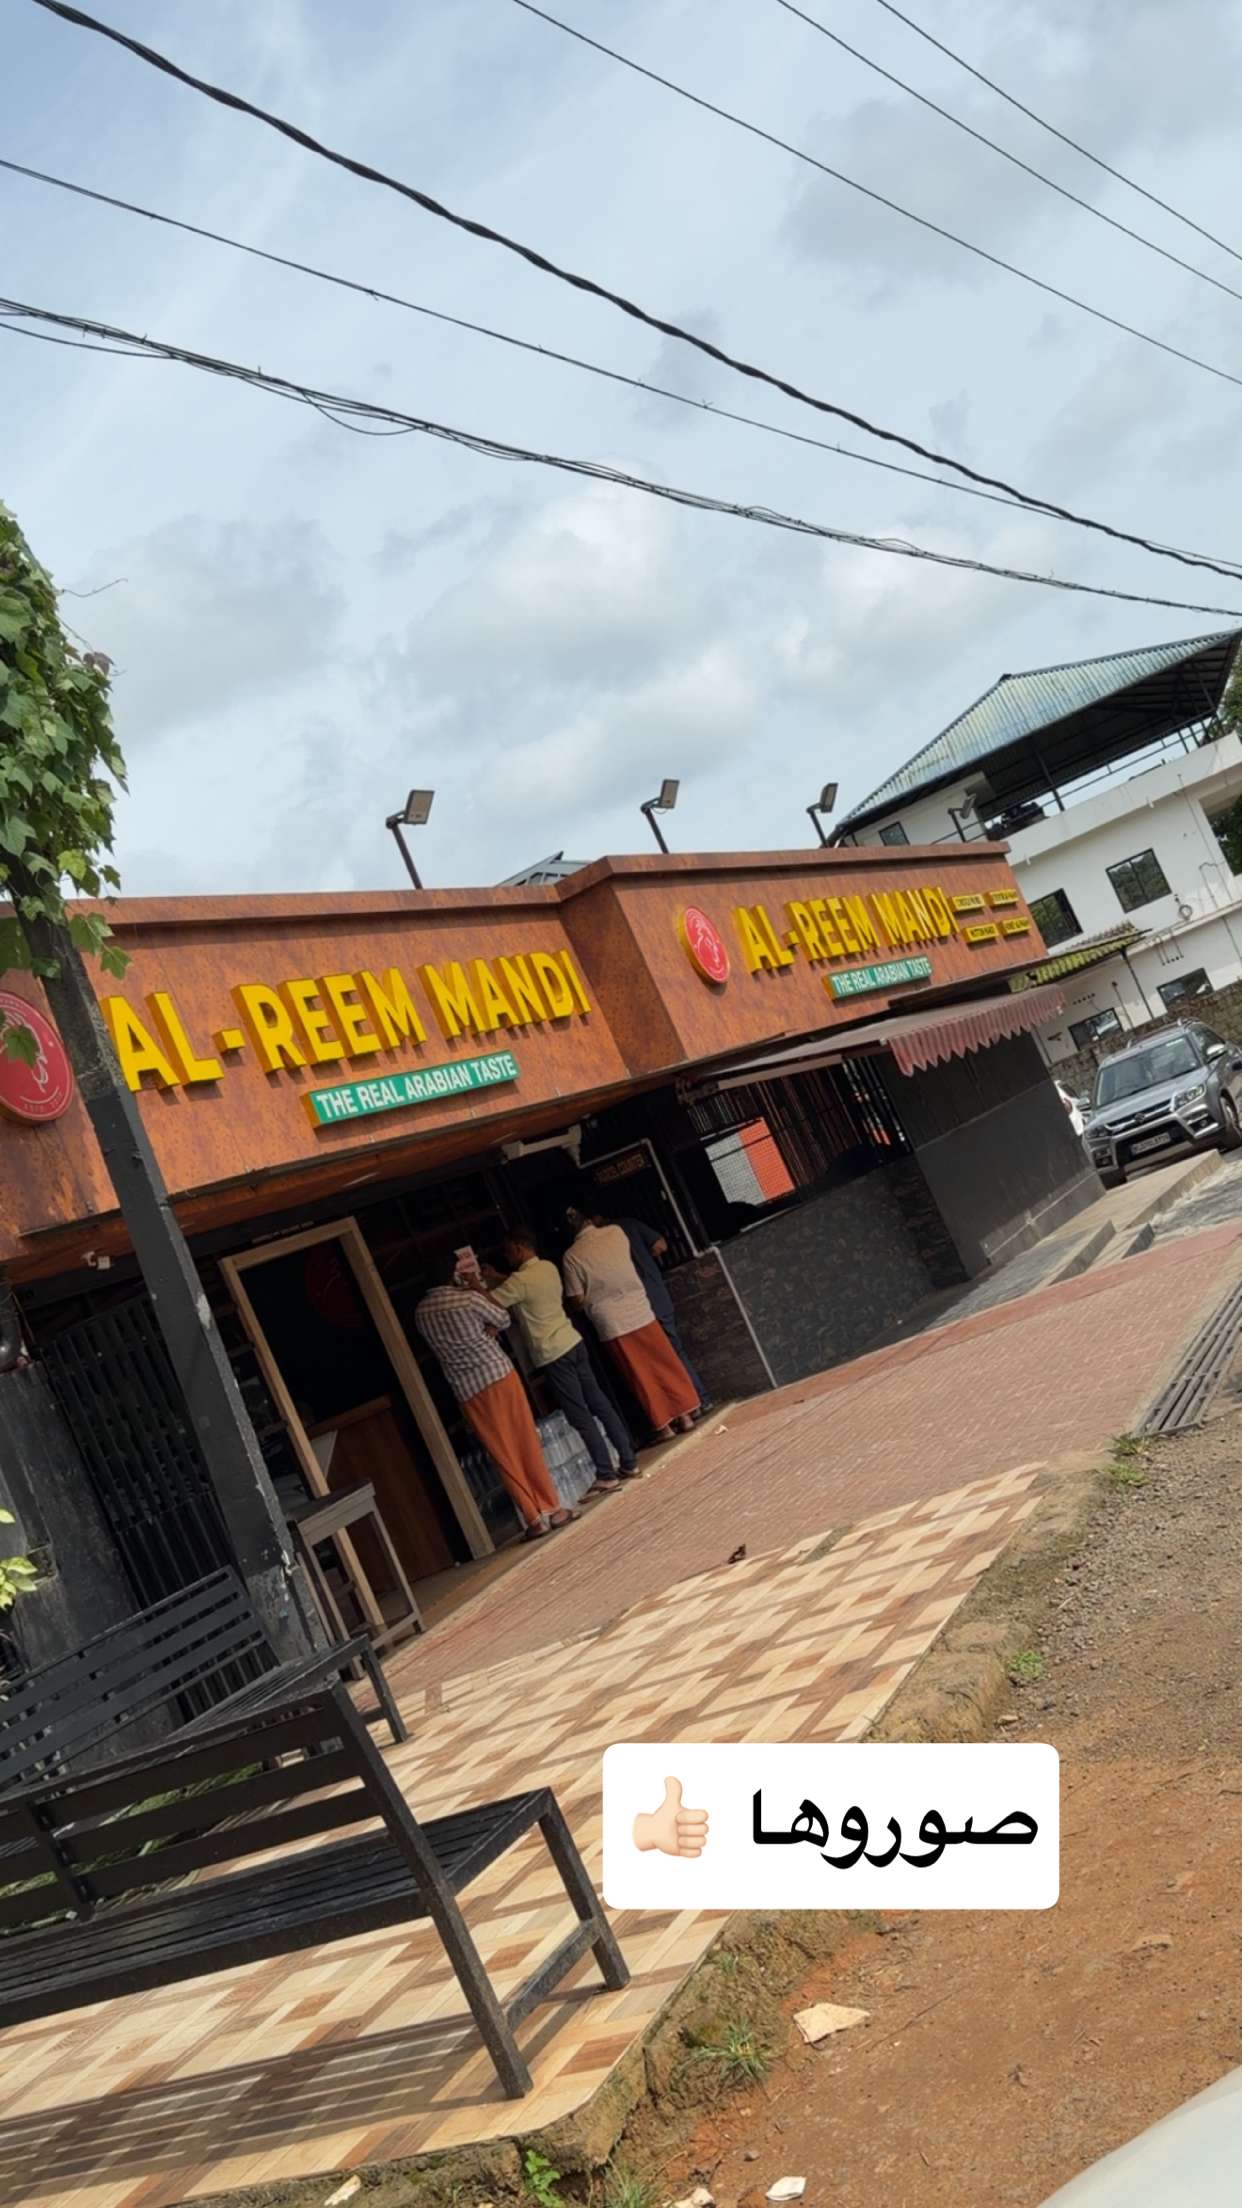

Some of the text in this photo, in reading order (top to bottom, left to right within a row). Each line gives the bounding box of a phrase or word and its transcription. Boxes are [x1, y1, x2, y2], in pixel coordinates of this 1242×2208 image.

[735, 887, 960, 972] AL-REEM MANDI
[831, 957, 932, 996] THE REAL ARABIAN TASTE
[102, 950, 591, 1092] AL-REEM MANDI
[316, 1053, 517, 1118] THE REAL ARABIAN TASTE
